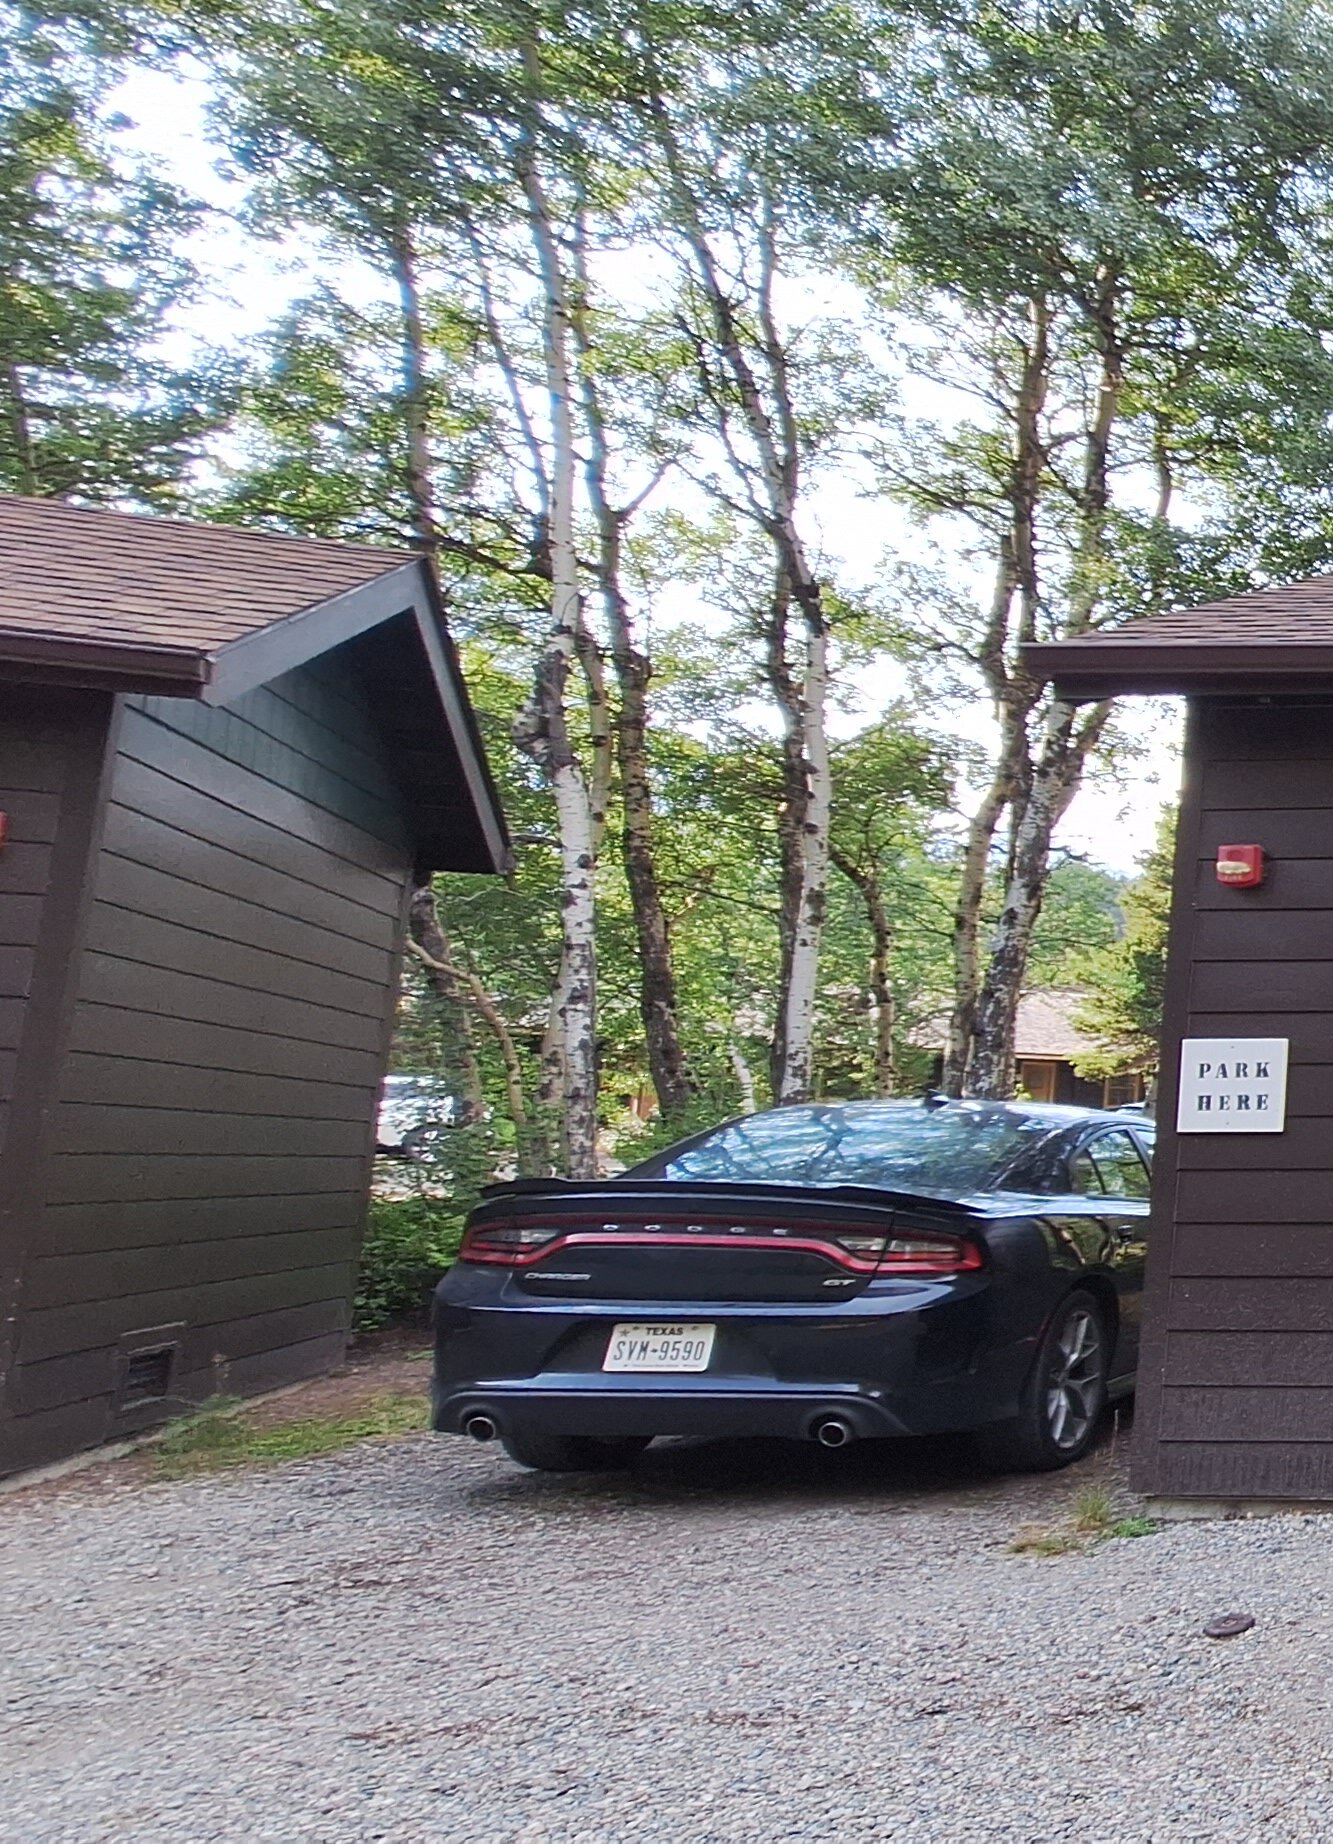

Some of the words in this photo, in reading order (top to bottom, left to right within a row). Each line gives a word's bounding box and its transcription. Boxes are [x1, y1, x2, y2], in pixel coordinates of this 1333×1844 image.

[1198, 1062, 1270, 1079] PARK
[1197, 1094, 1269, 1111] HERE
[645, 1326, 684, 1336] TEXAS
